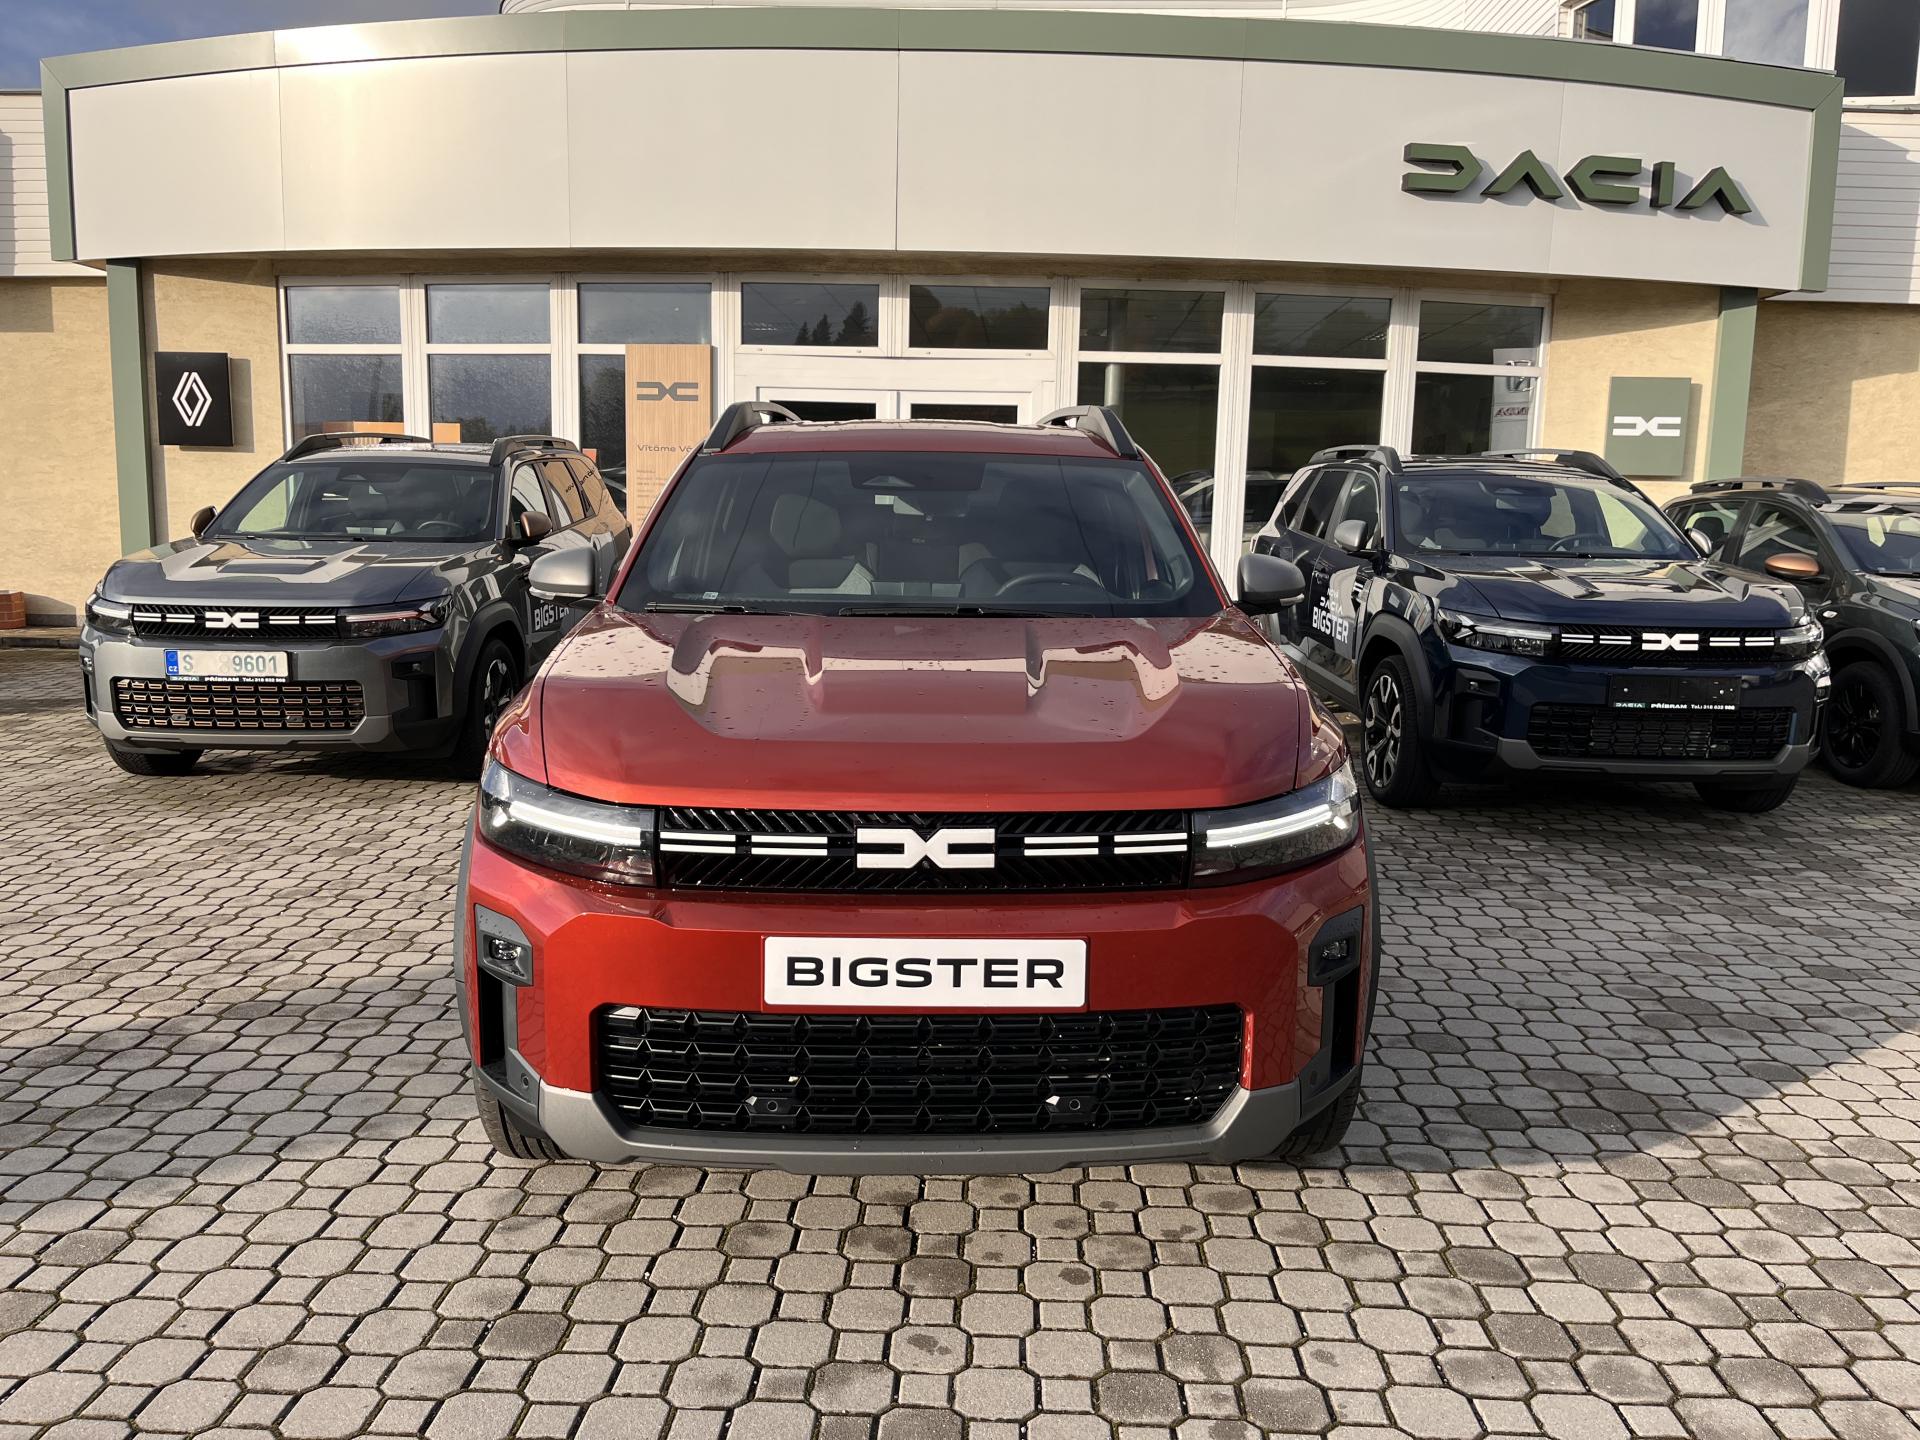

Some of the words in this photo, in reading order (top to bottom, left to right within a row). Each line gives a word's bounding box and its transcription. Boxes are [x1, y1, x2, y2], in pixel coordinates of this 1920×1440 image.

[1401, 142, 1752, 215] DACIA
[1312, 606, 1349, 644] BIGSTER
[232, 655, 278, 673] 9601
[786, 956, 1064, 988] BIGSTER
